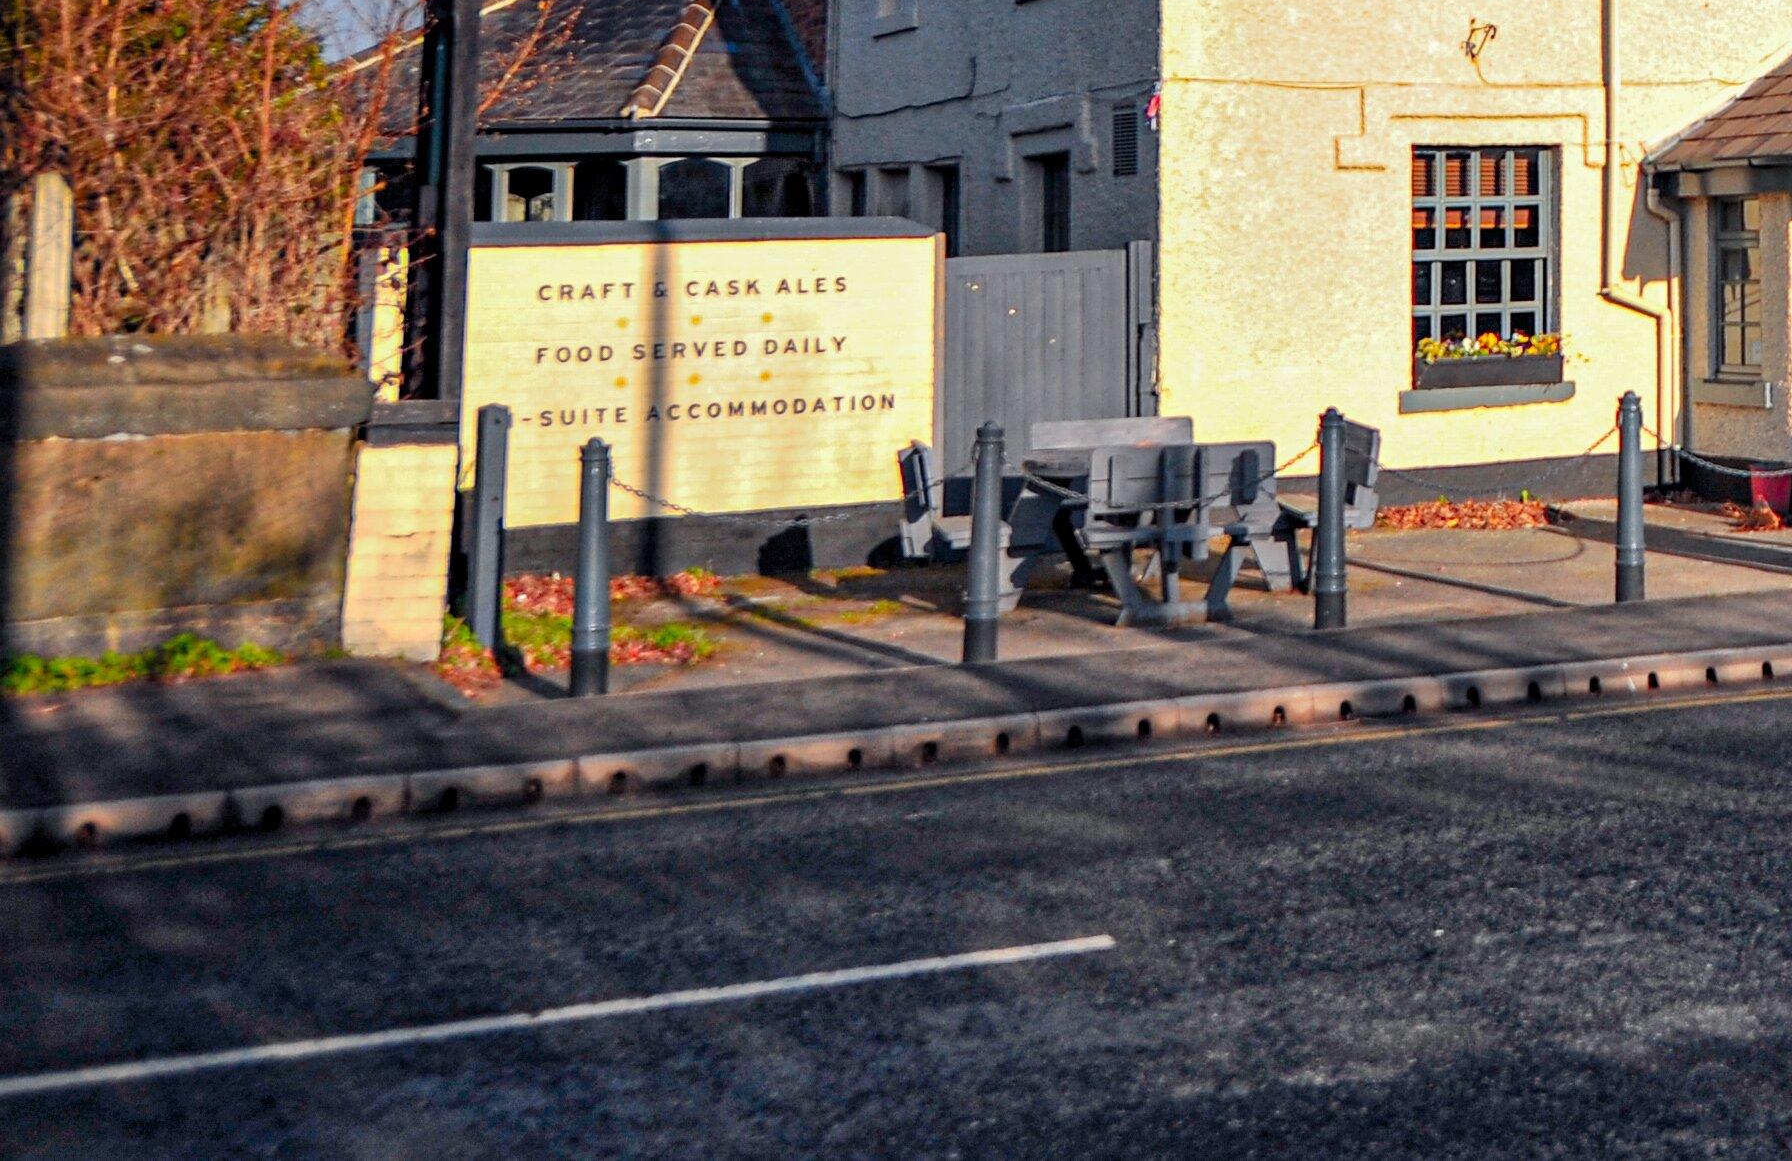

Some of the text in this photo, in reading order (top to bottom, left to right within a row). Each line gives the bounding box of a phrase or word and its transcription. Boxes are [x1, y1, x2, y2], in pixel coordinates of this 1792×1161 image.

[537, 276, 850, 302] CRAFT & CASK ALES
[535, 335, 849, 365] FOOD SERVED DAILY
[646, 392, 897, 421] ACCOMMODATION
